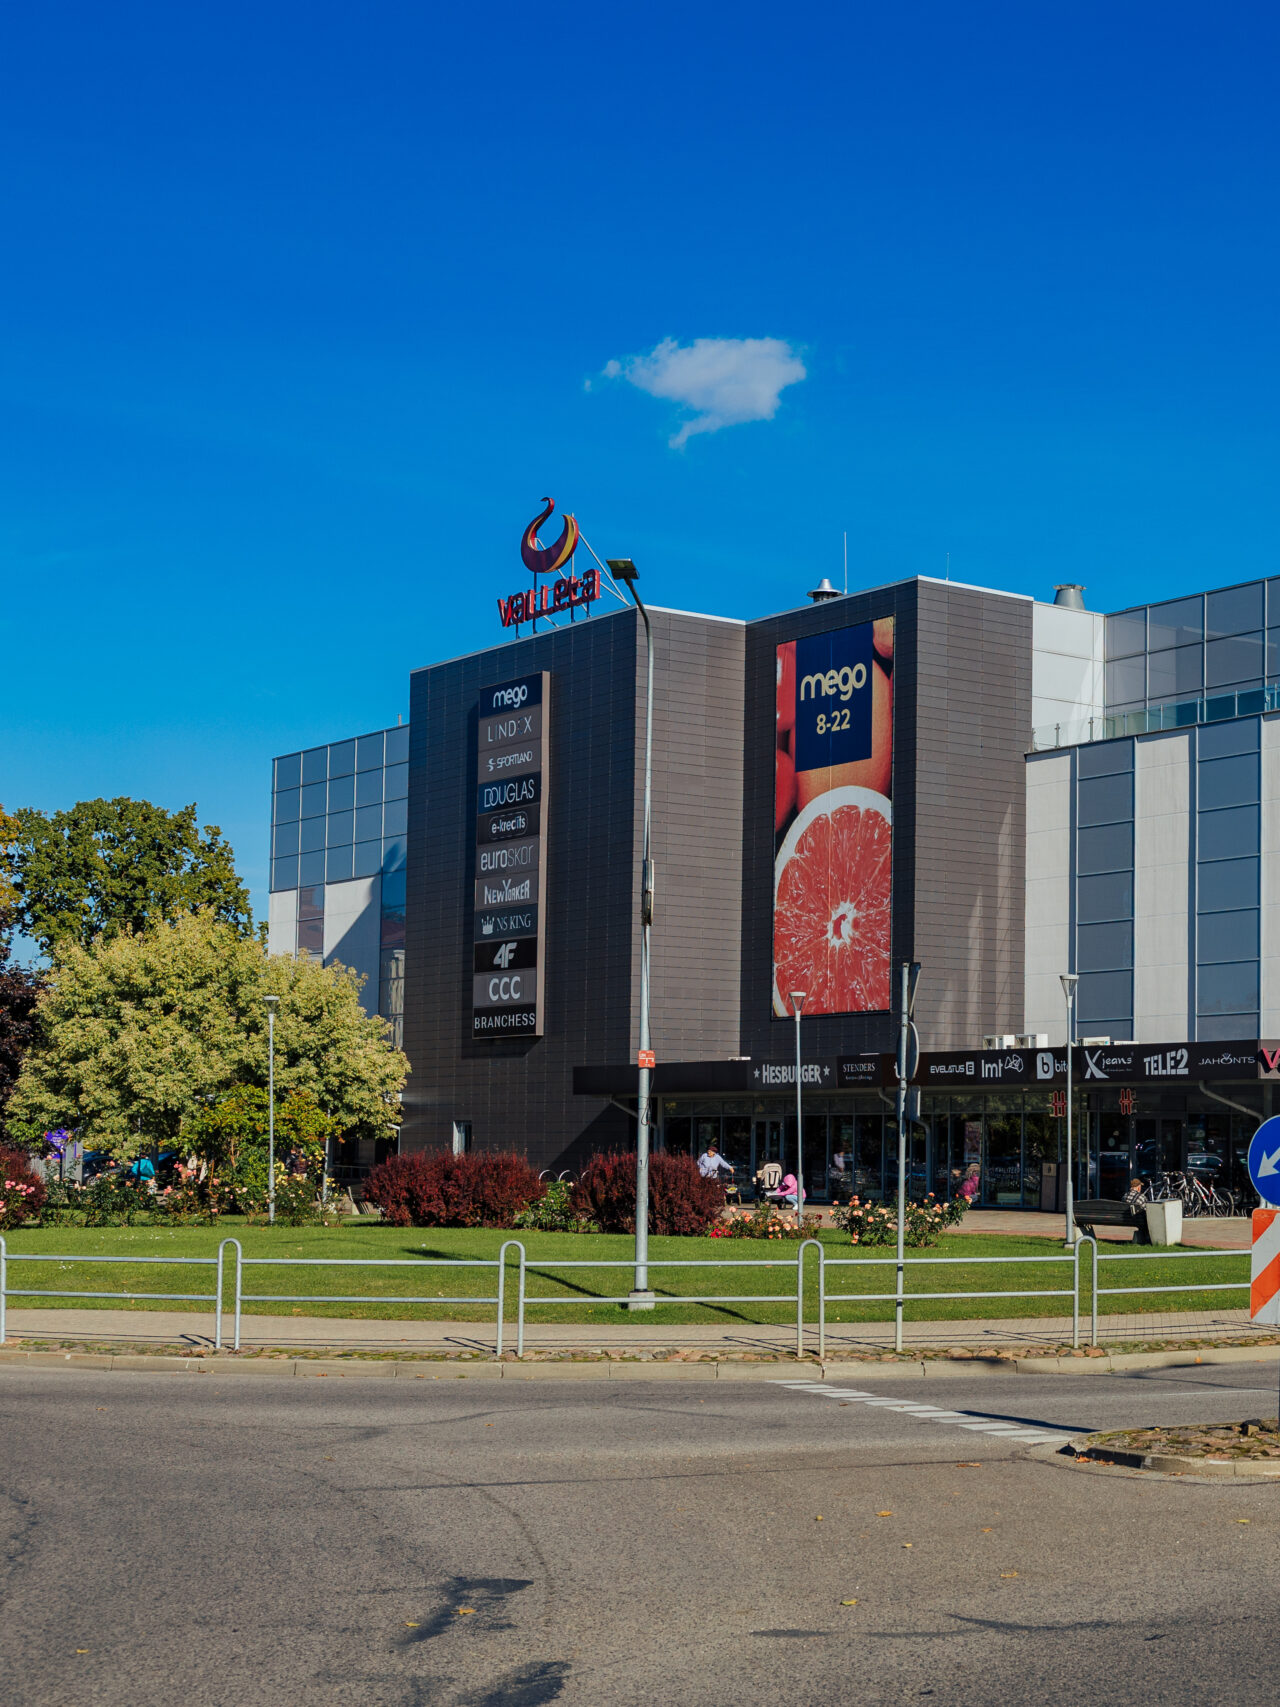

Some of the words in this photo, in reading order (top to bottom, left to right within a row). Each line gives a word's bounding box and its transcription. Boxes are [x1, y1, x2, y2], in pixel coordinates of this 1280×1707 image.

[801, 663, 867, 701] mego
[493, 685, 528, 708] mego
[816, 708, 850, 734] 8-22
[496, 751, 532, 769] SPORTLAND
[484, 779, 534, 808] DOUGLAS
[510, 914, 531, 929] KING
[493, 942, 517, 968] 4F
[489, 976, 520, 1001] CCC
[475, 1013, 536, 1029] BRANCHESS
[930, 1065, 964, 1073] EVELATUS
[1085, 1050, 1110, 1078] X
[1102, 1053, 1132, 1069] jeans
[1144, 1048, 1189, 1075] TELE2
